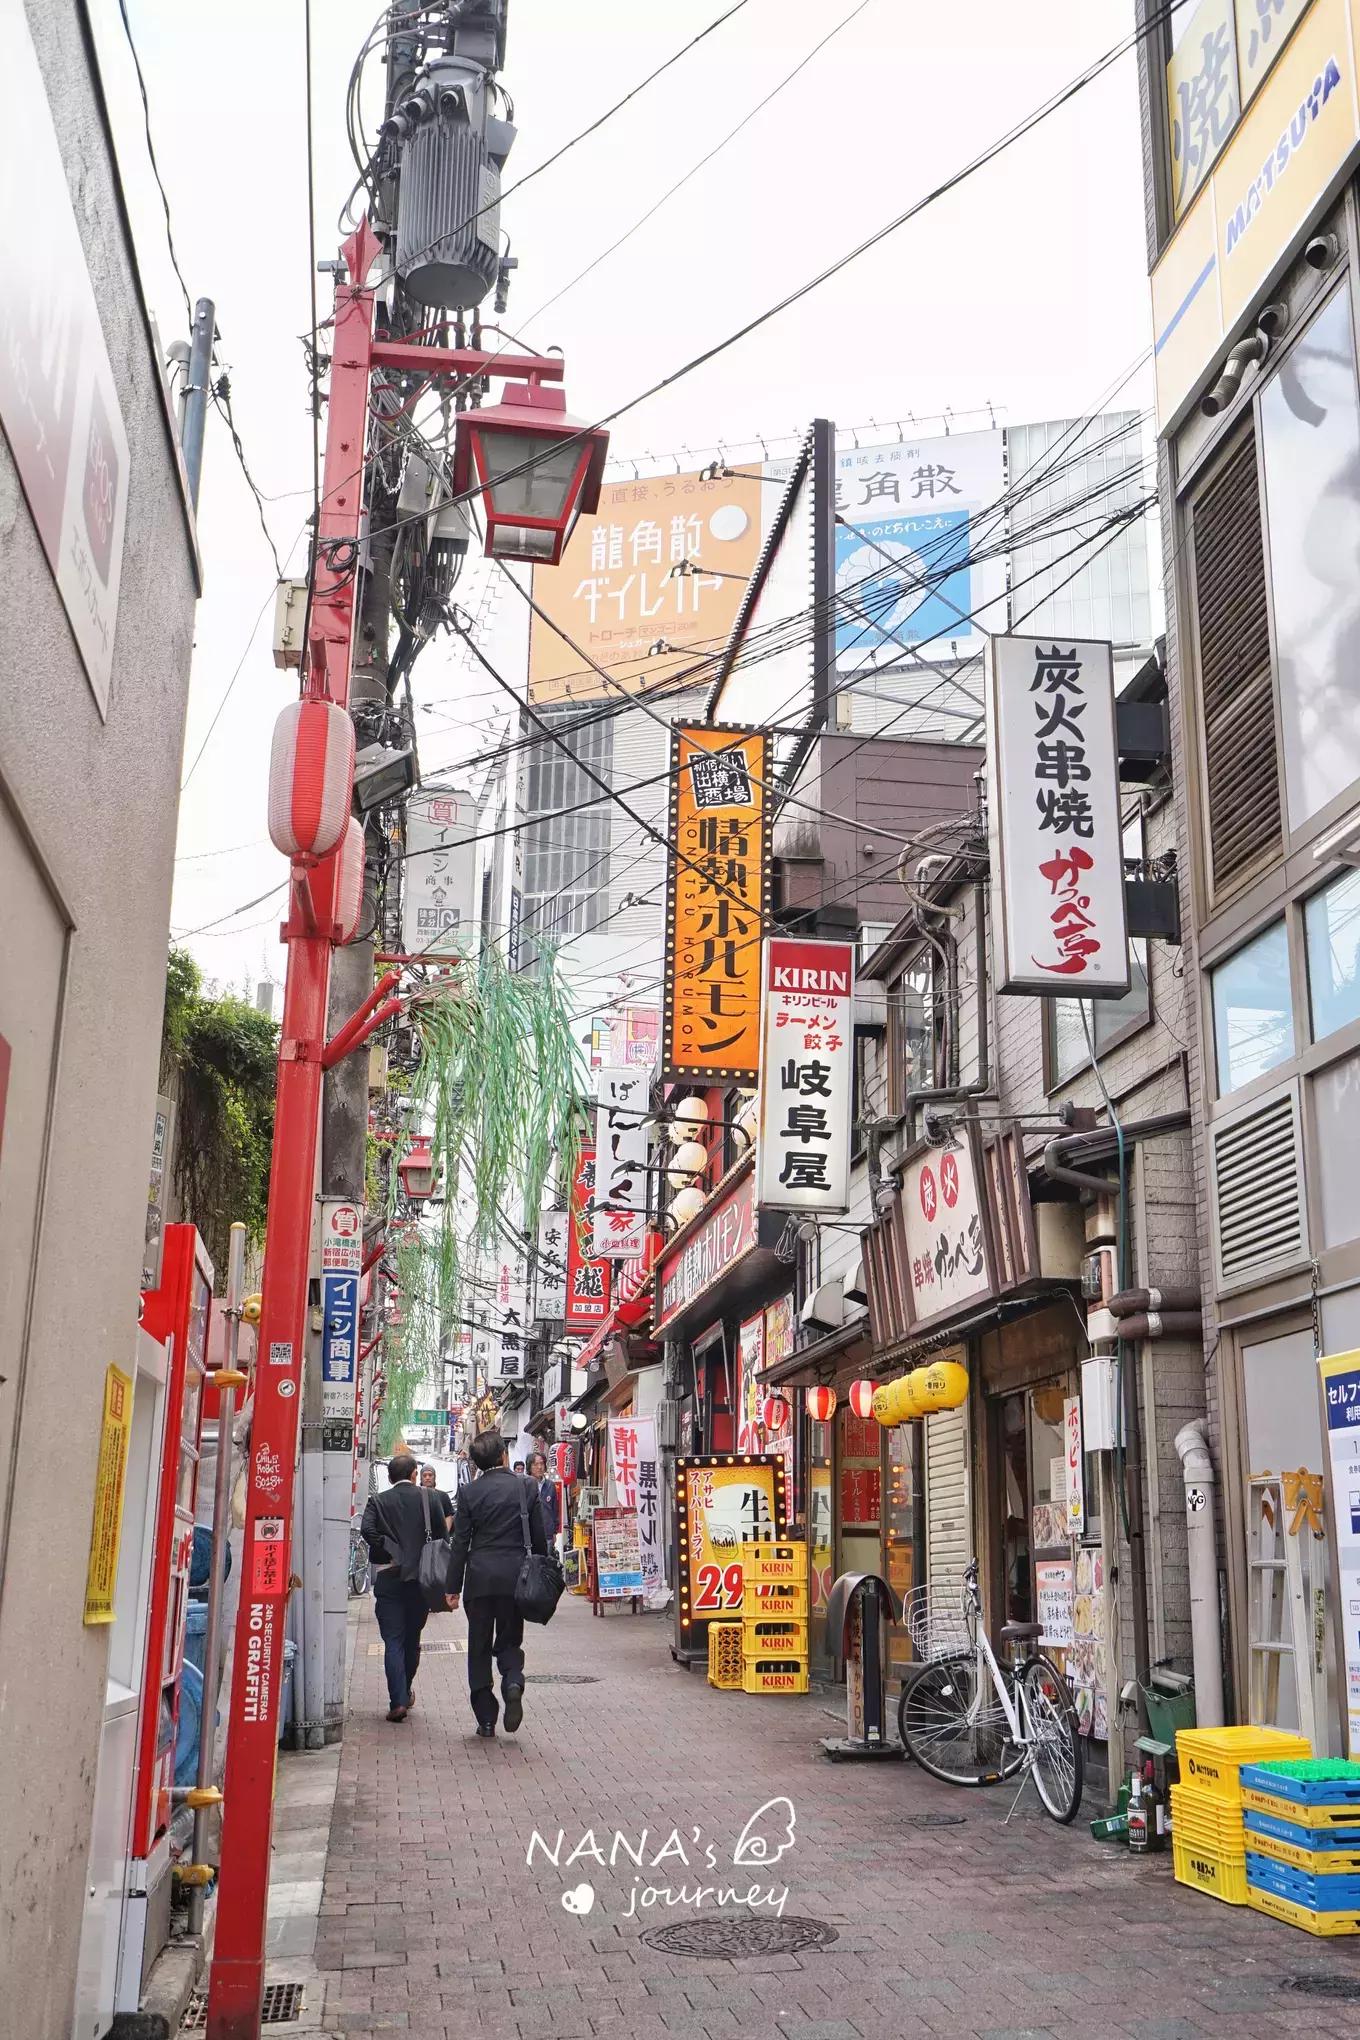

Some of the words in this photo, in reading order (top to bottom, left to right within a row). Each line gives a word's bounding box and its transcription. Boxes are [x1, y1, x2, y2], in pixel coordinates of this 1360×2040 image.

[591, 512, 703, 572] 龍角散
[573, 568, 724, 623] ダイレクト
[589, 627, 637, 643] トローチ
[1029, 645, 1095, 838] 炭火串焼
[698, 785, 749, 804] 酒場
[684, 815, 698, 917] JONTSU
[1031, 846, 1102, 974] かっぺ亭
[696, 816, 750, 1054] 情熱ホルモン
[682, 937, 695, 1053] HORUMON
[774, 967, 848, 992] KIRIN
[782, 995, 837, 1008] キリンビール
[776, 1012, 837, 1031] ラーメン
[804, 1034, 843, 1052] 餃子
[780, 1059, 832, 1192] 岐阜屋
[328, 1279, 353, 1382] イニシ商事
[574, 1303, 602, 1313] 加盟店
[500, 1307, 521, 1375] 大黒屋
[1328, 1381, 1360, 1405] セルフ
[1068, 1405, 1081, 1489] ホッピー
[703, 1472, 715, 1509] アサヒ
[689, 1471, 703, 1560] スーパードライ
[695, 1563, 744, 1610] 29
[762, 1563, 794, 1573] KIRIN
[249, 1603, 263, 1631] NO
[265, 1603, 274, 1621] 24h
[761, 1600, 793, 1610] KIRIN
[262, 1622, 272, 1671] SECURITY
[761, 1637, 793, 1647] KIRIN
[244, 1635, 261, 1722] GRAFFITI
[259, 1672, 270, 1721] CAMERAS
[762, 1675, 794, 1685] KIRIN
